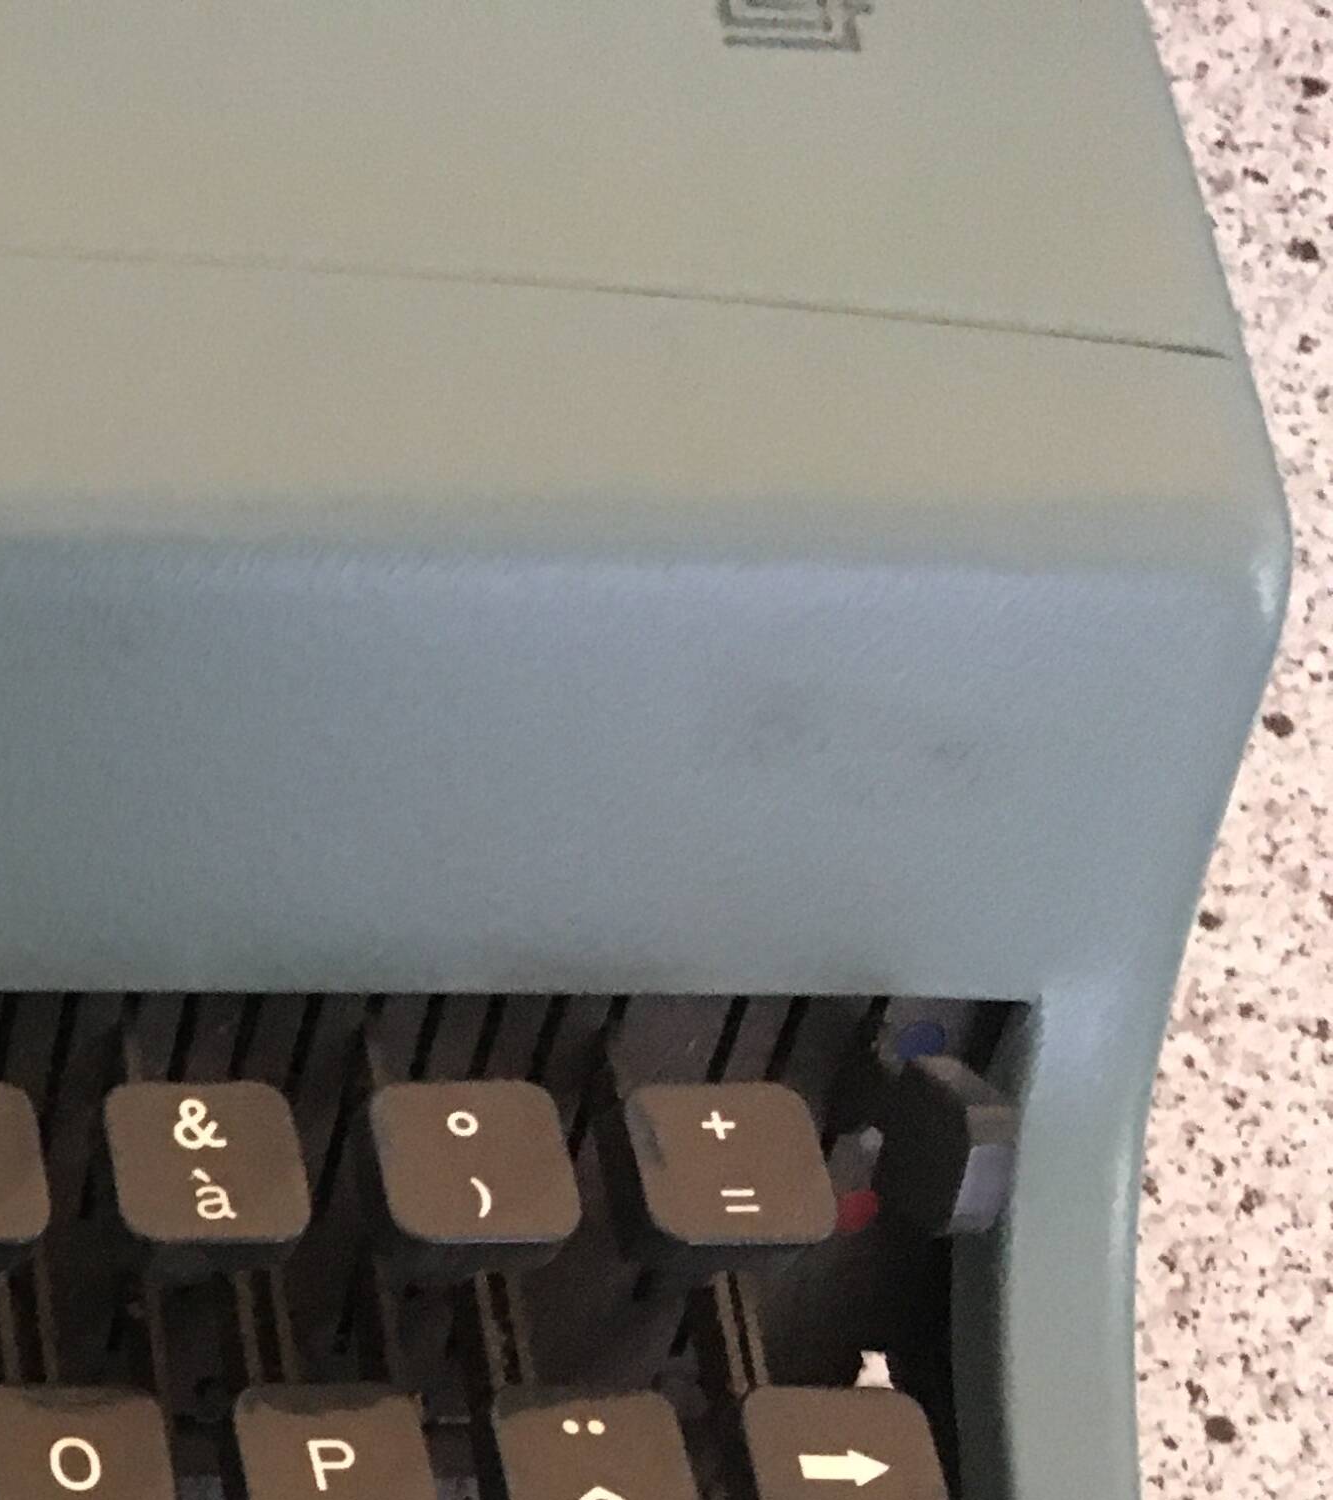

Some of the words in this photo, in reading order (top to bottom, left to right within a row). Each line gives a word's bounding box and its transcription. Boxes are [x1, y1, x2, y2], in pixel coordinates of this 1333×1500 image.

[171, 1096, 230, 1152] &
[699, 1108, 738, 1142] +
[189, 1166, 239, 1222] à
[468, 1175, 494, 1220] )
[718, 1186, 762, 1215] =
[47, 1435, 103, 1493] O
[305, 1437, 358, 1493] P
